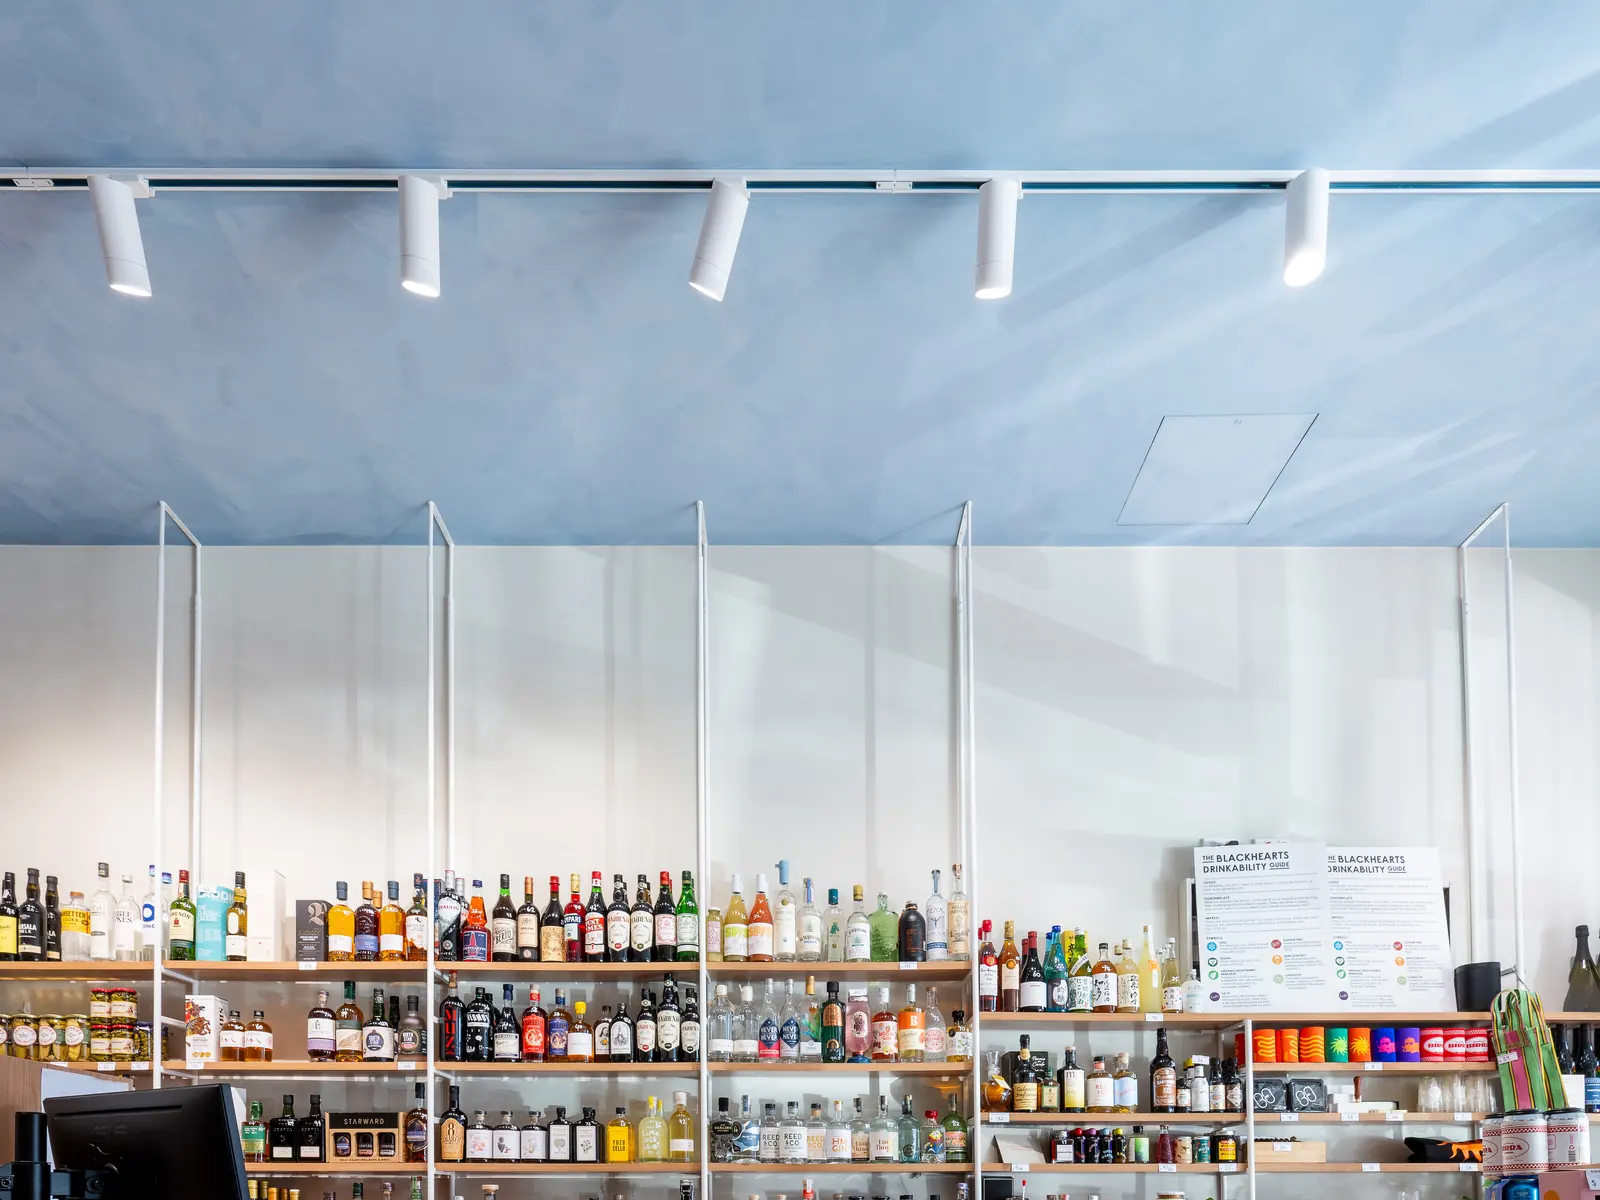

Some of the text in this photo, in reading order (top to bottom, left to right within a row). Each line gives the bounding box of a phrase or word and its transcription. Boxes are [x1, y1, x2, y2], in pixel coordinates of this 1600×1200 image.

[1216, 851, 1289, 863] BLACKHEARTS
[1338, 855, 1406, 864] BLACKHEARTS
[1203, 863, 1267, 874] DRINKABILITY
[910, 1015, 919, 1026] B
